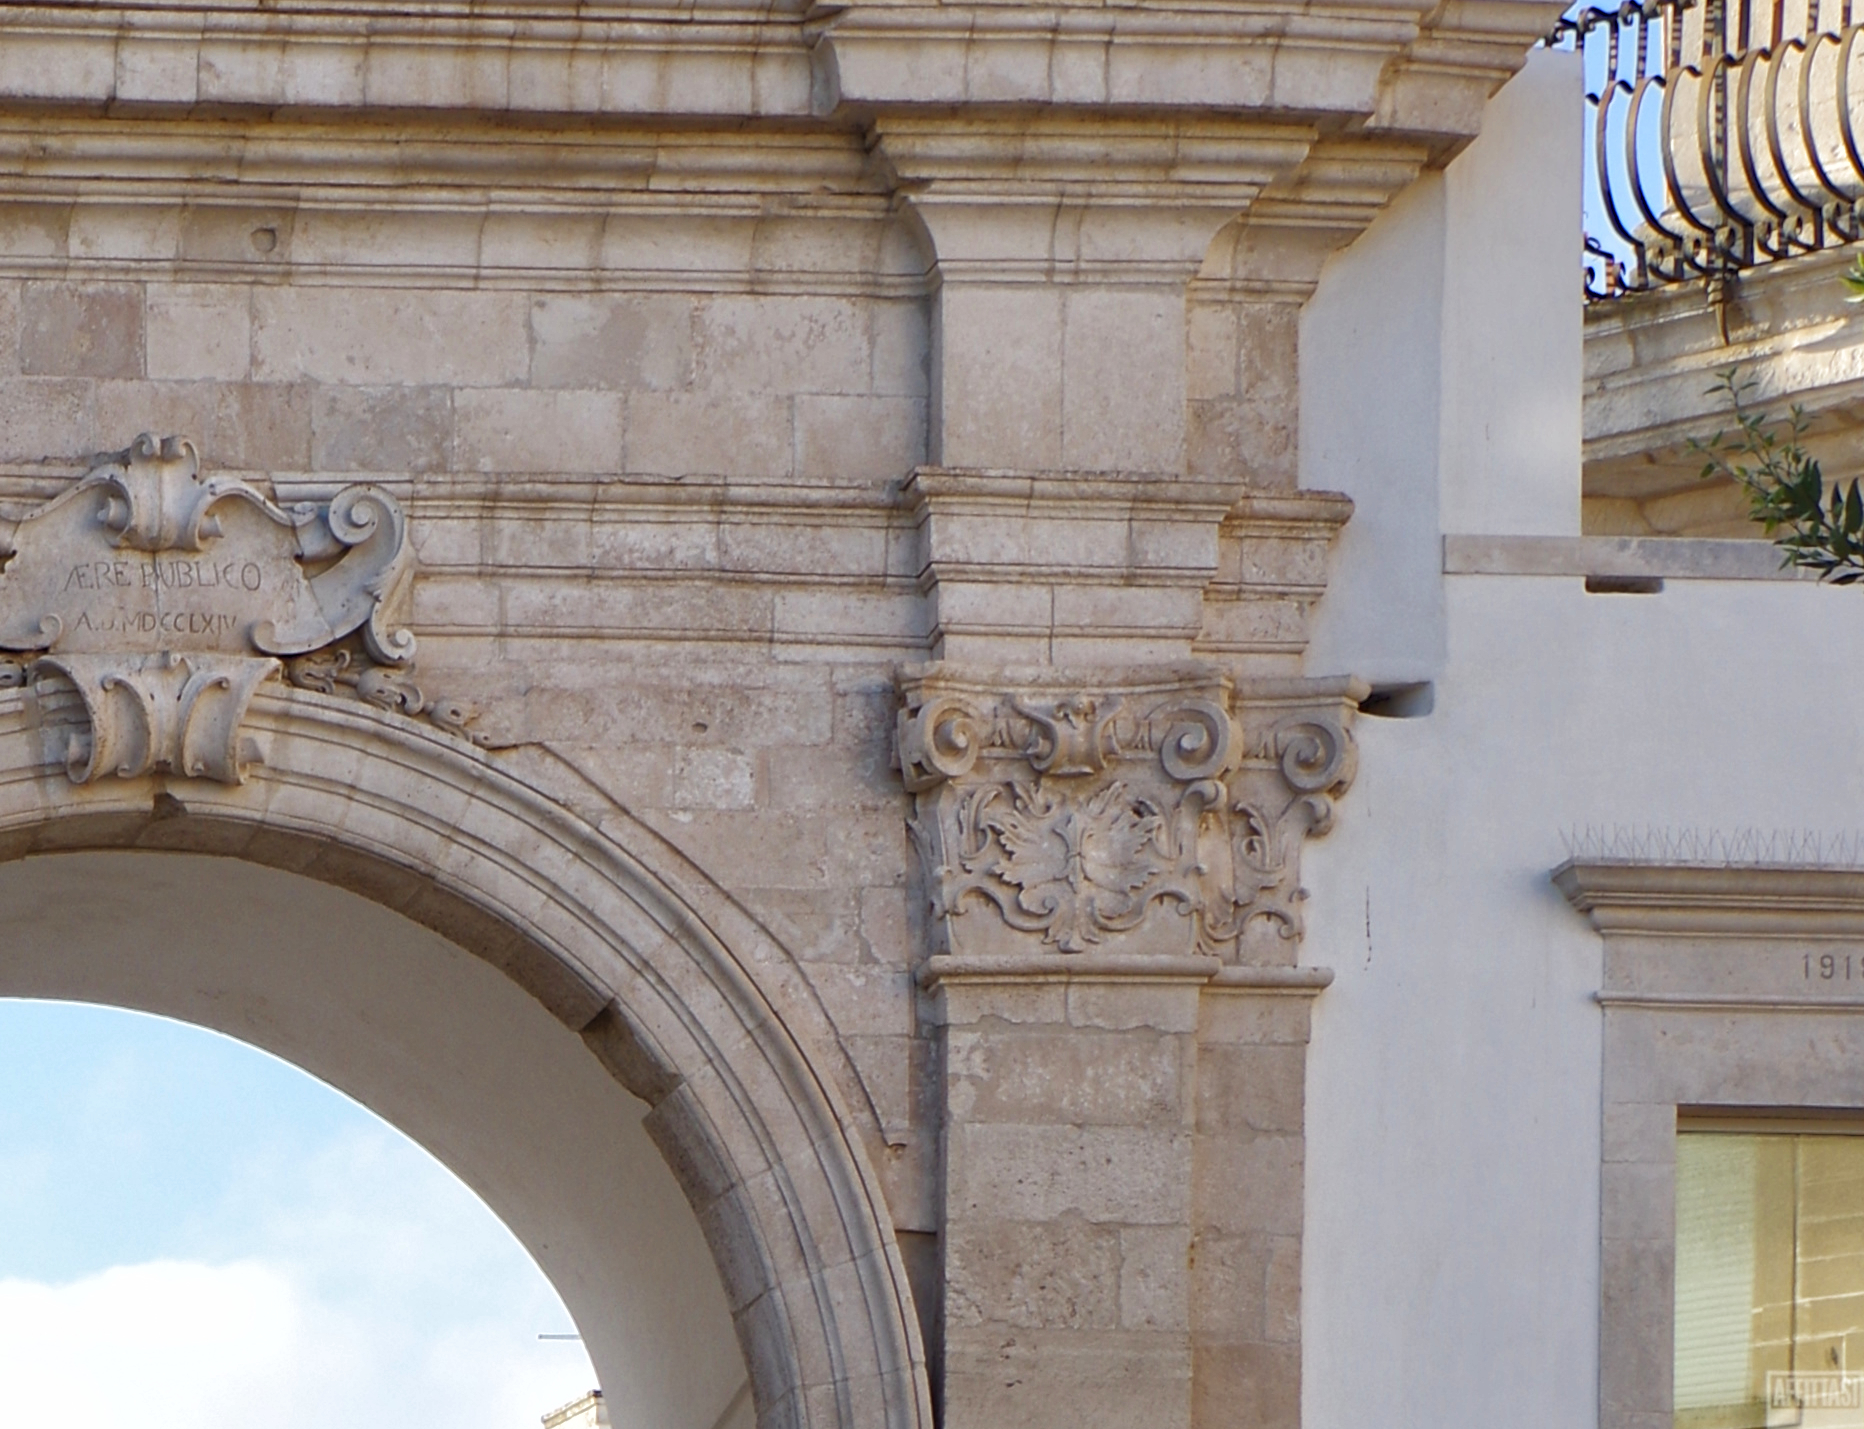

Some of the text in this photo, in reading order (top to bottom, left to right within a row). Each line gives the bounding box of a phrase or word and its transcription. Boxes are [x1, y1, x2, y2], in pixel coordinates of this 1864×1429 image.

[141, 560, 261, 591] PUBLICO
[1802, 952, 1864, 981] 191
[1773, 1377, 1859, 1407] AFFITTASI
